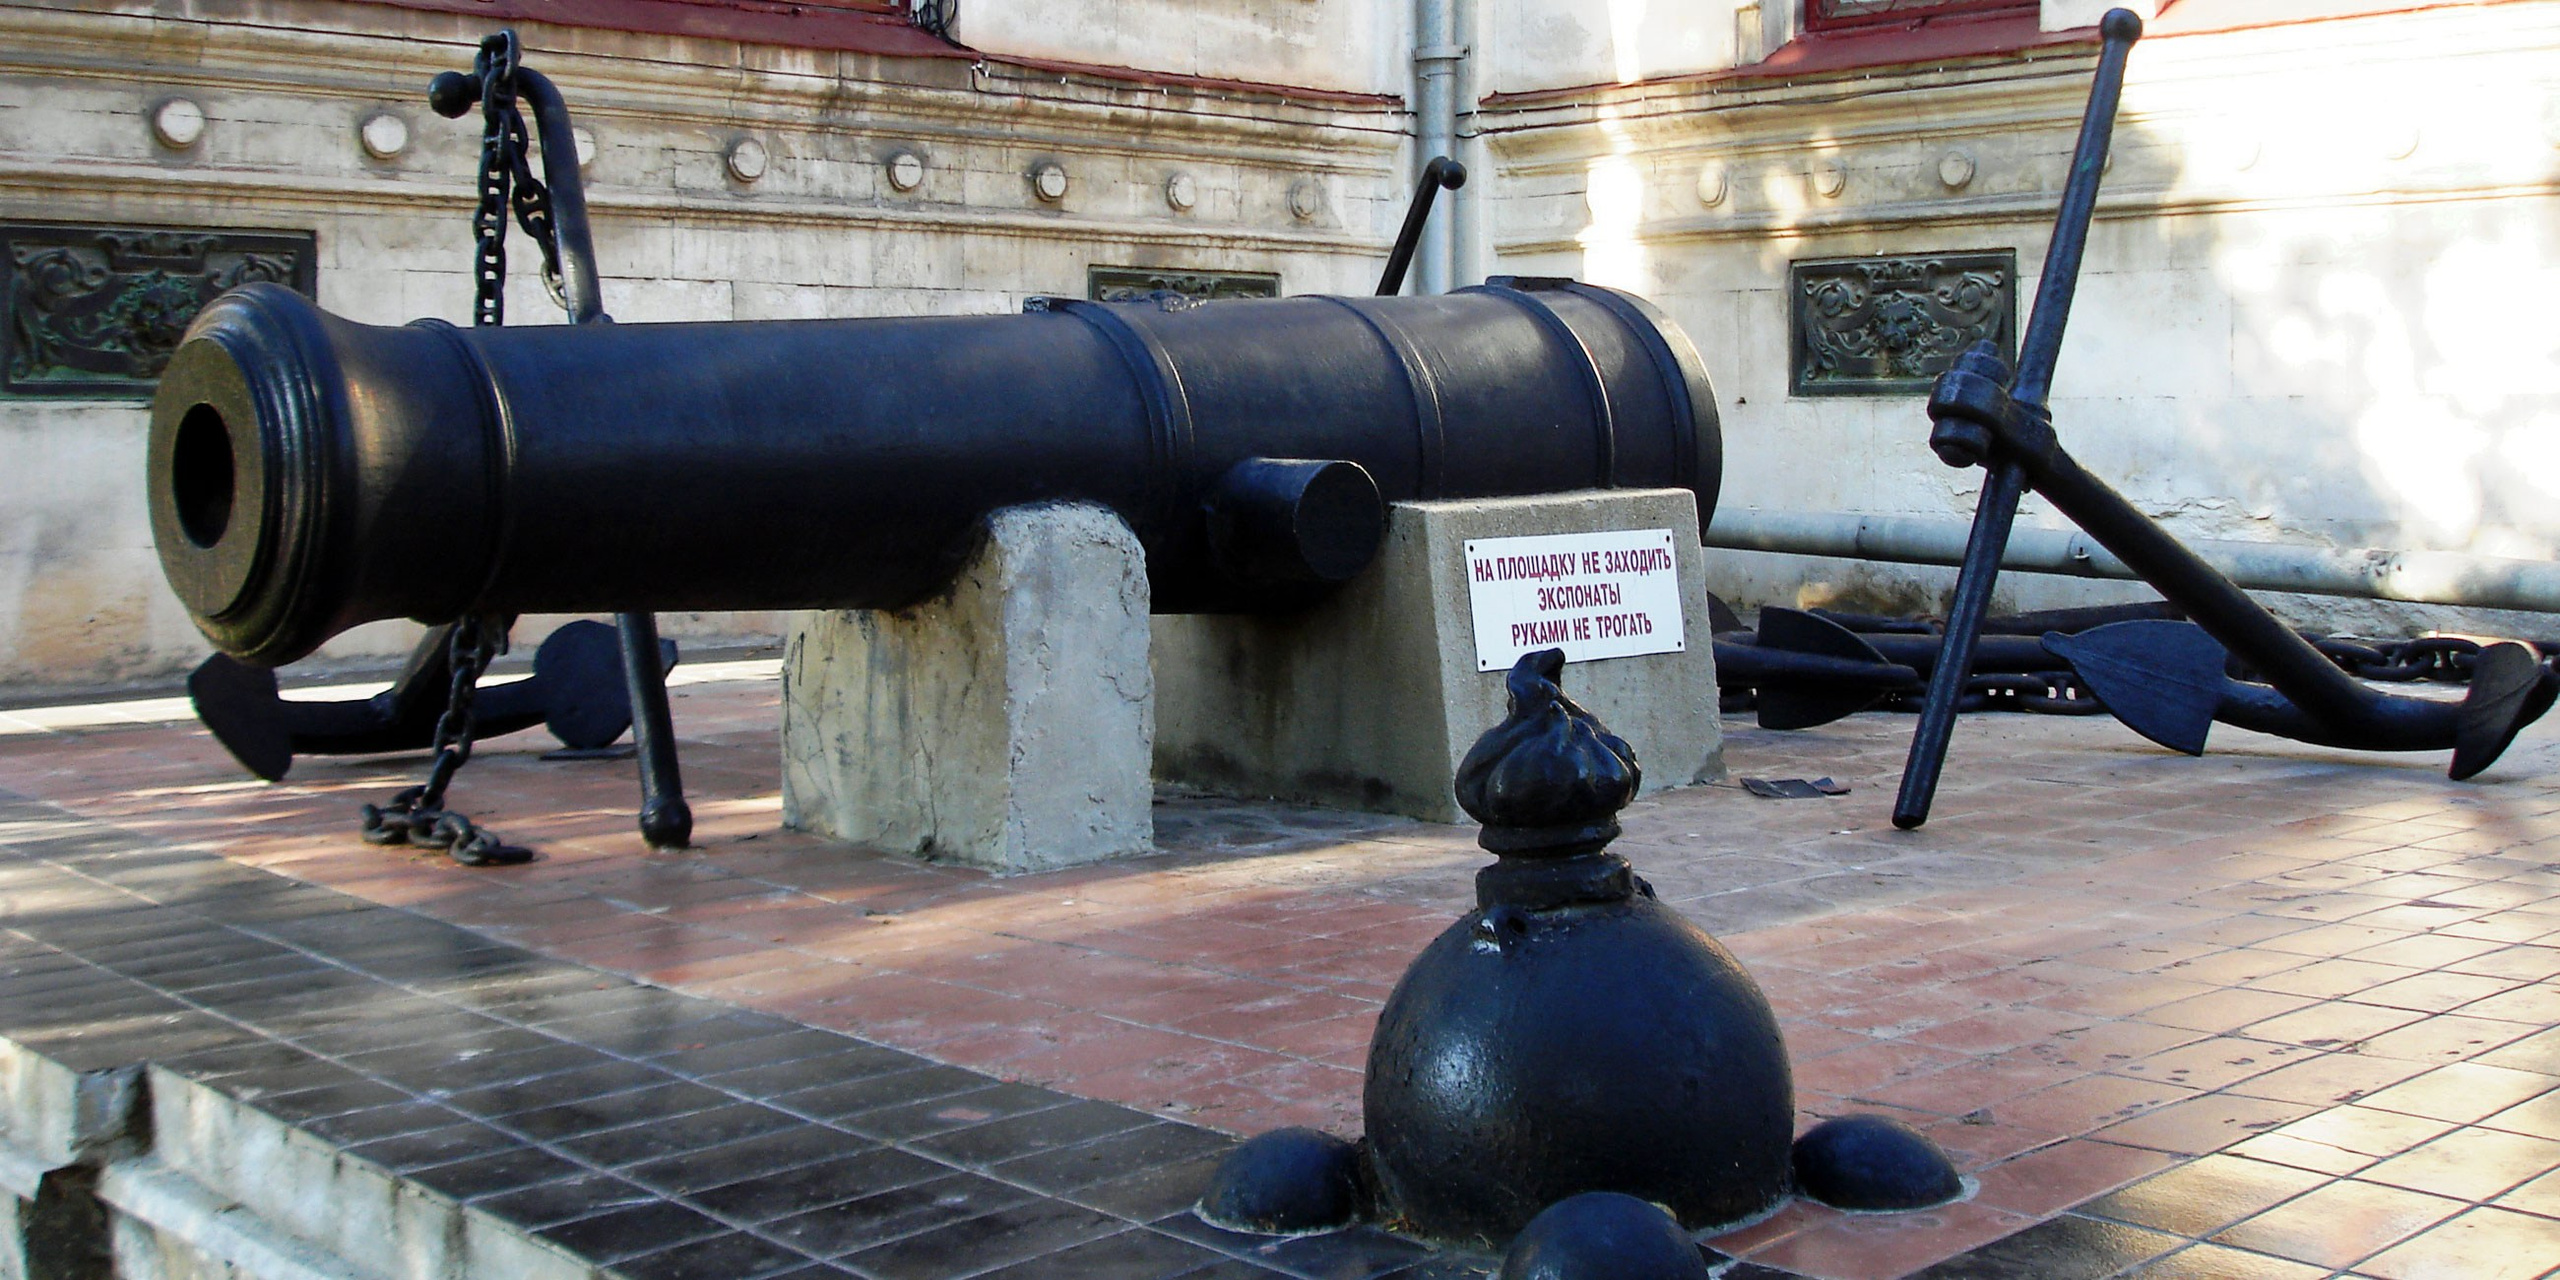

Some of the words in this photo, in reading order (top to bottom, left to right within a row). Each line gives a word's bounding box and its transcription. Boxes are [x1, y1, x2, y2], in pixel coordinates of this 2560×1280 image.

[1474, 558, 1494, 582] НА
[1496, 552, 1576, 581] ПЛОЩАДКУ
[1581, 551, 1601, 574] НЕ
[1604, 548, 1672, 576] ЗАХОДИТЬ
[1537, 583, 1622, 611] ЭКСПОНАТЫ
[1511, 619, 1569, 647] РУКАМИ
[1573, 616, 1591, 640] НЕ
[1595, 612, 1653, 638] ТРОГАТЬ
